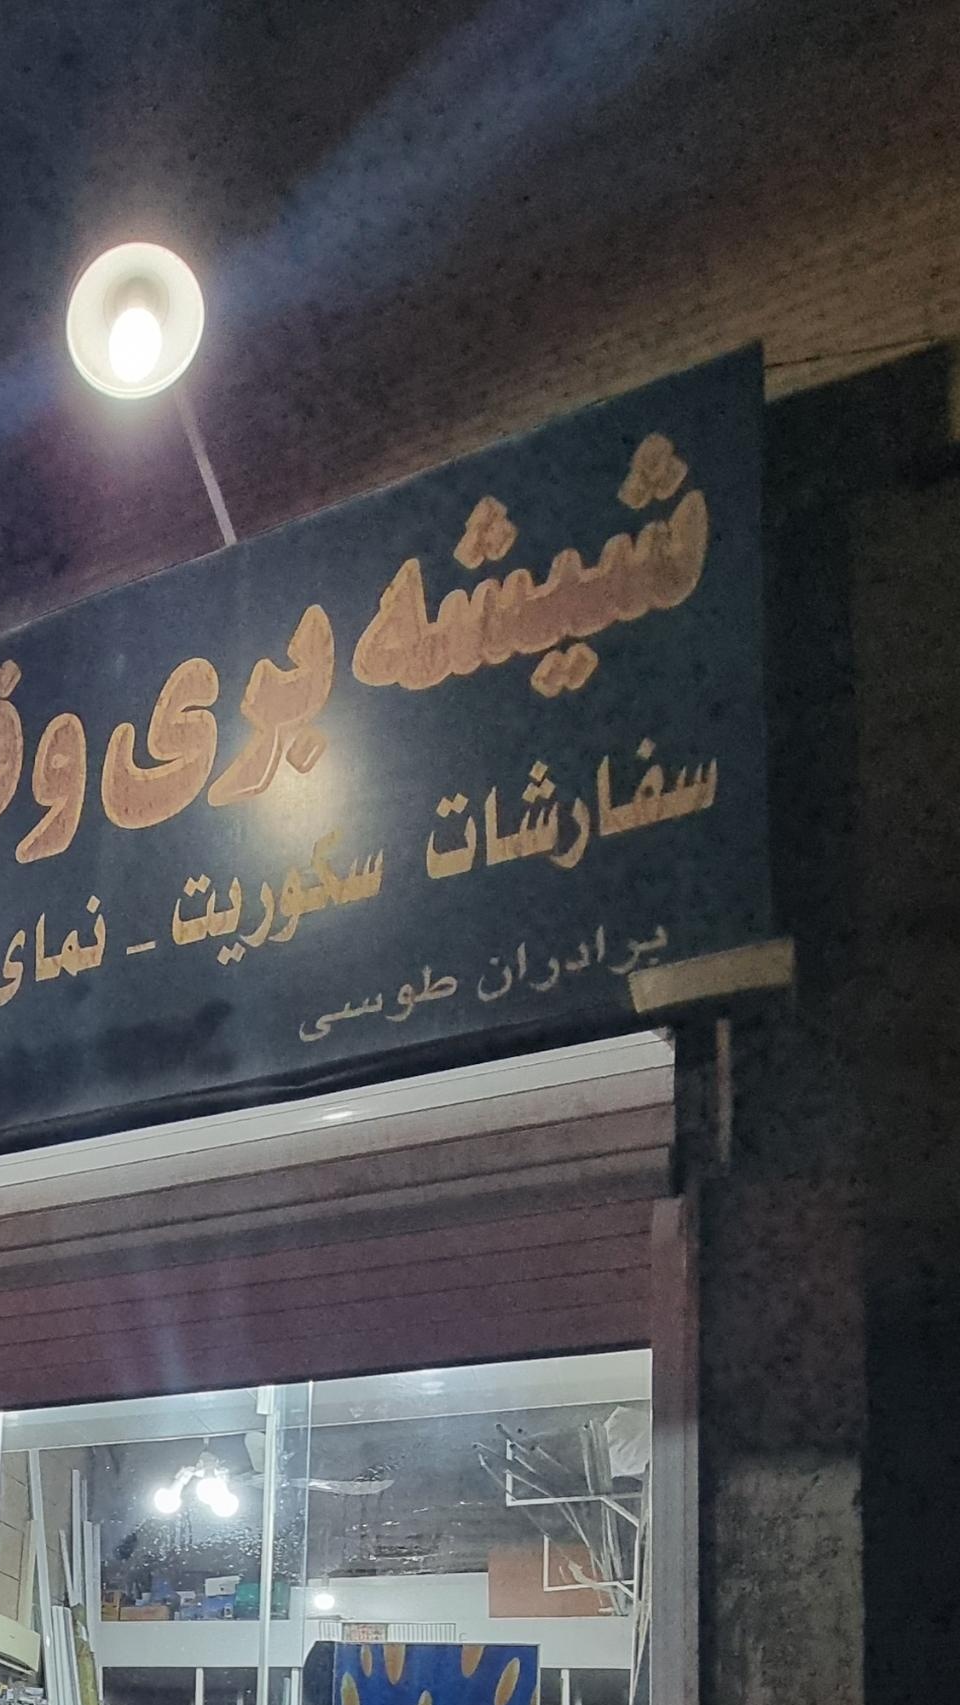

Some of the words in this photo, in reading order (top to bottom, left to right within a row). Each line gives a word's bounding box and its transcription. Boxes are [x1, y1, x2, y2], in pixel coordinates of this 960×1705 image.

[353, 433, 709, 697] شیشه
[102, 604, 334, 829] بری
[426, 738, 717, 879] سفارشات
[172, 830, 384, 965] سکوریت
[478, 925, 668, 1001] برادران
[299, 965, 459, 1042] طوسی
